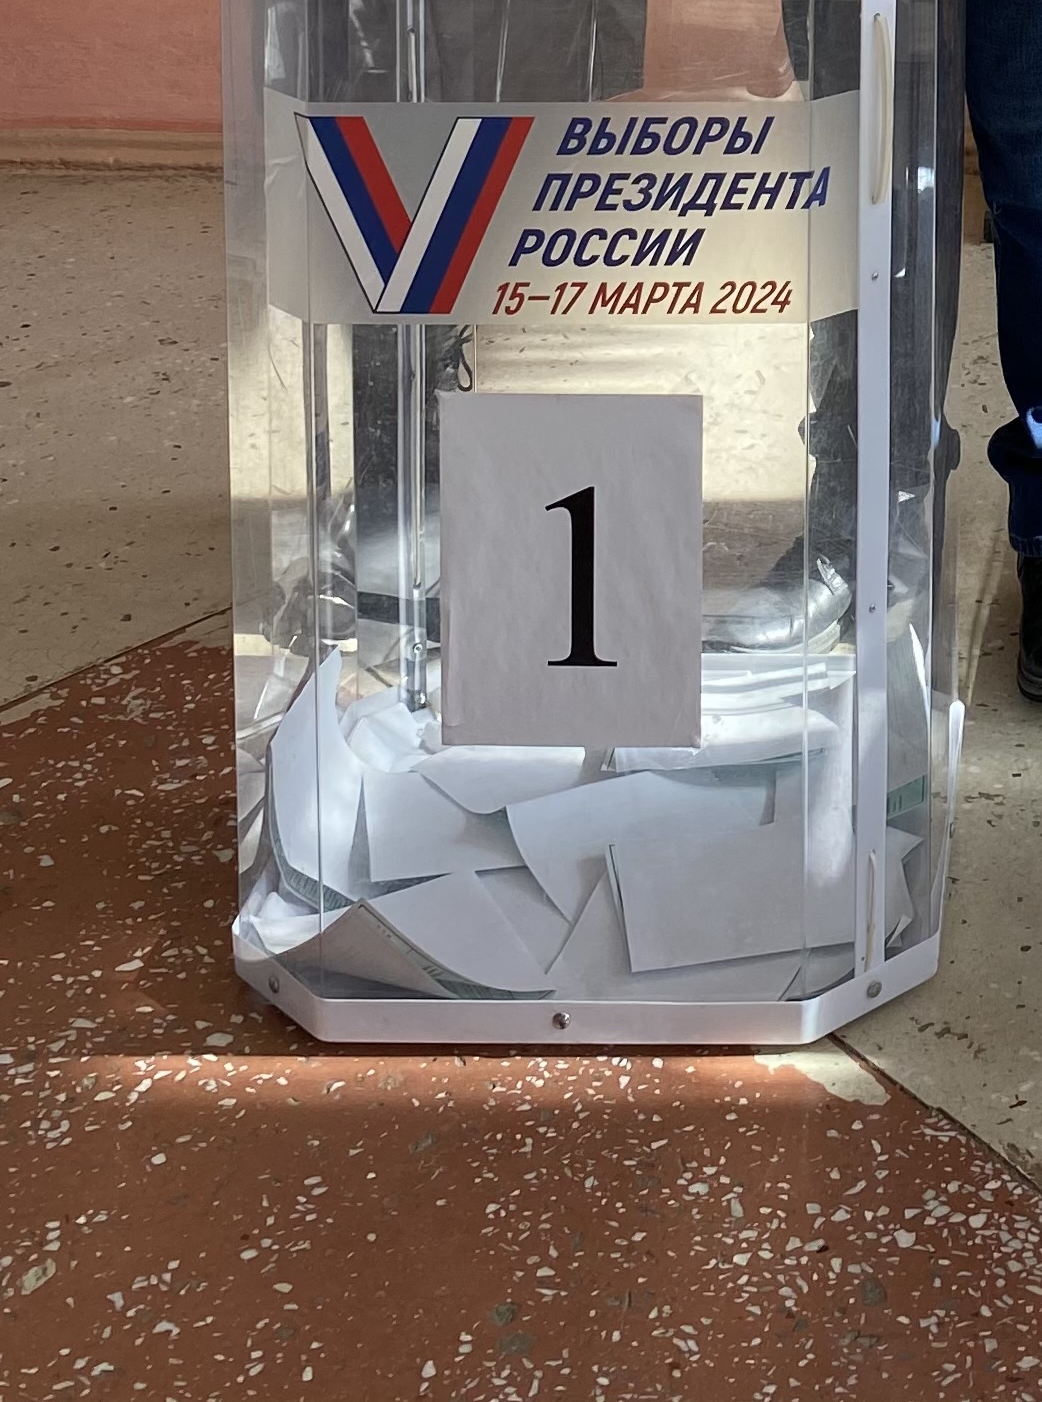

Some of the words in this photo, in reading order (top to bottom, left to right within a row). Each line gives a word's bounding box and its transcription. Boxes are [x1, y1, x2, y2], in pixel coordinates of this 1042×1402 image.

[556, 115, 775, 157] ВЫБОРЫ
[531, 166, 831, 218] ПРЕЗИДЕНТА
[509, 228, 706, 267] РОССИИ
[588, 281, 704, 315] МАРТА
[709, 280, 793, 315] 2024
[545, 486, 618, 667] 1
